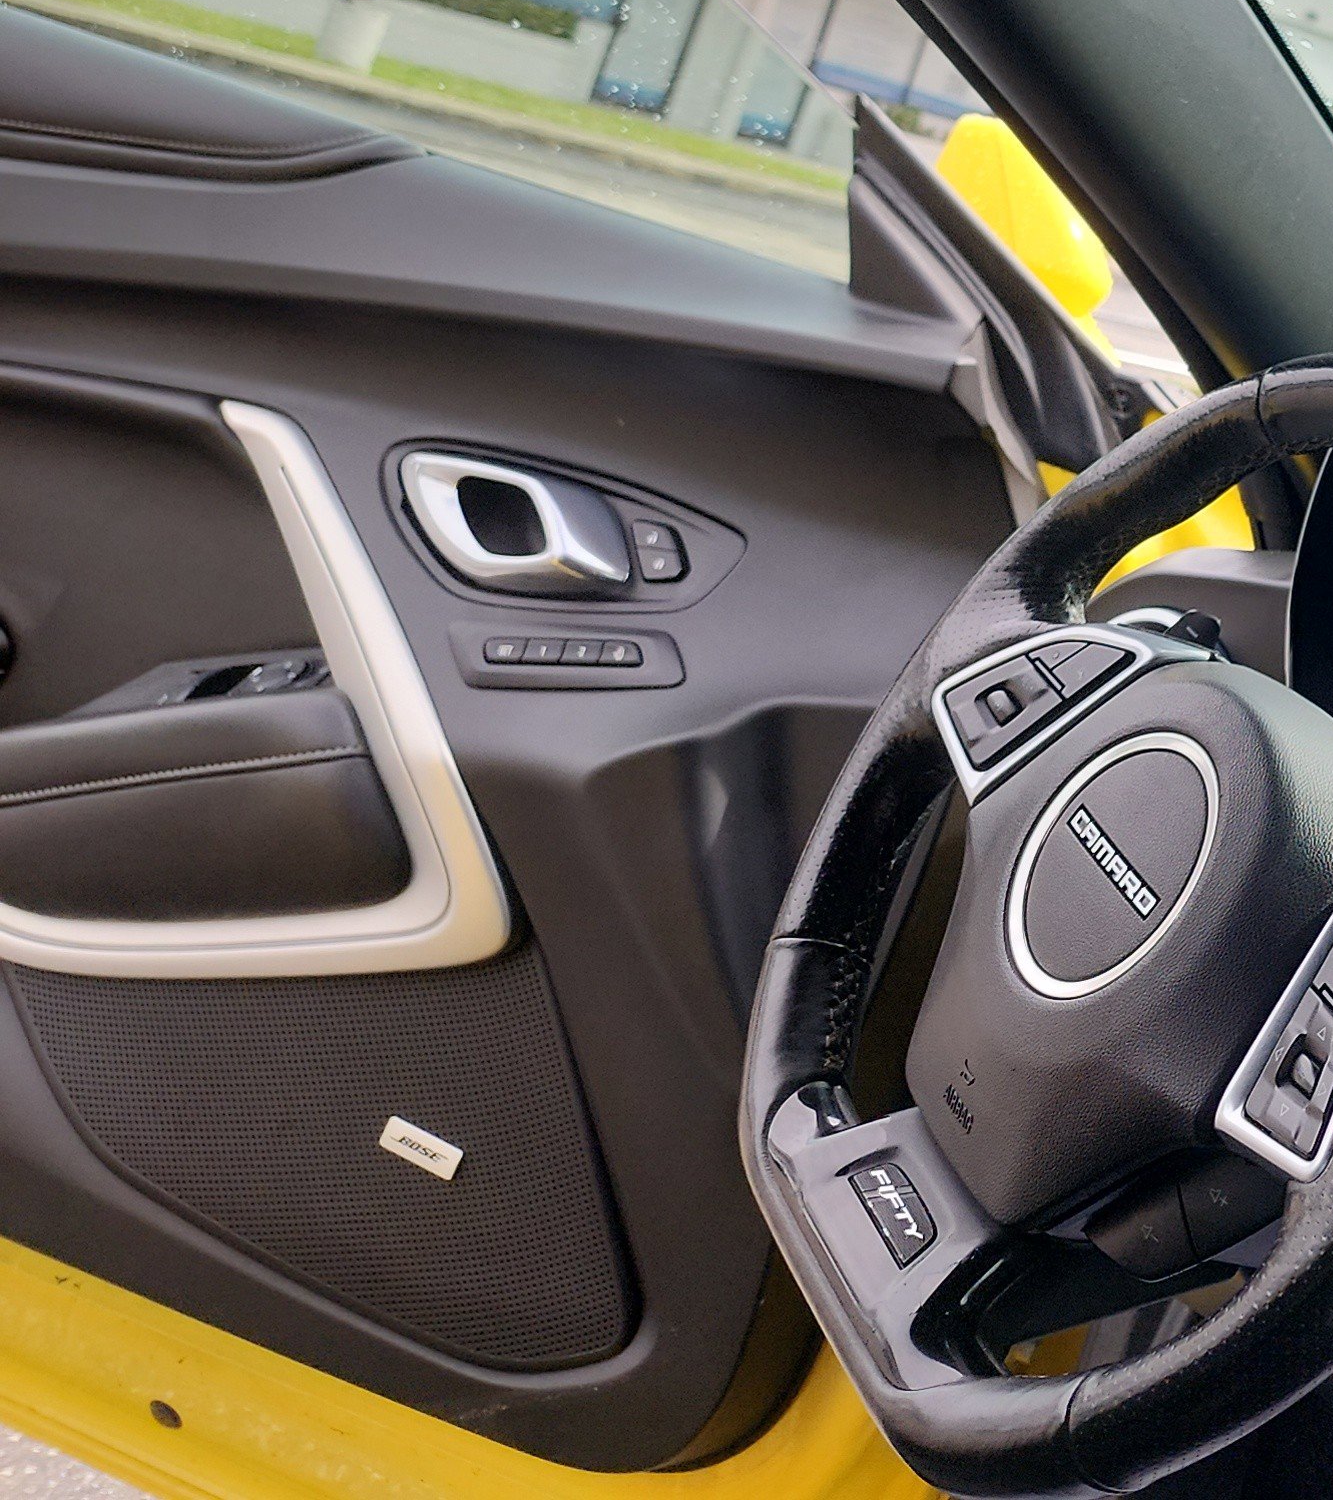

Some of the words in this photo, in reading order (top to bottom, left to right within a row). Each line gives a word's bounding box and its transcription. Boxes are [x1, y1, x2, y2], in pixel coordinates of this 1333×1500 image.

[1069, 808, 1158, 917] CAMARO
[943, 1083, 975, 1135] AIRBAG
[390, 1134, 449, 1163] BOSE
[869, 1169, 925, 1240] FIFTY
